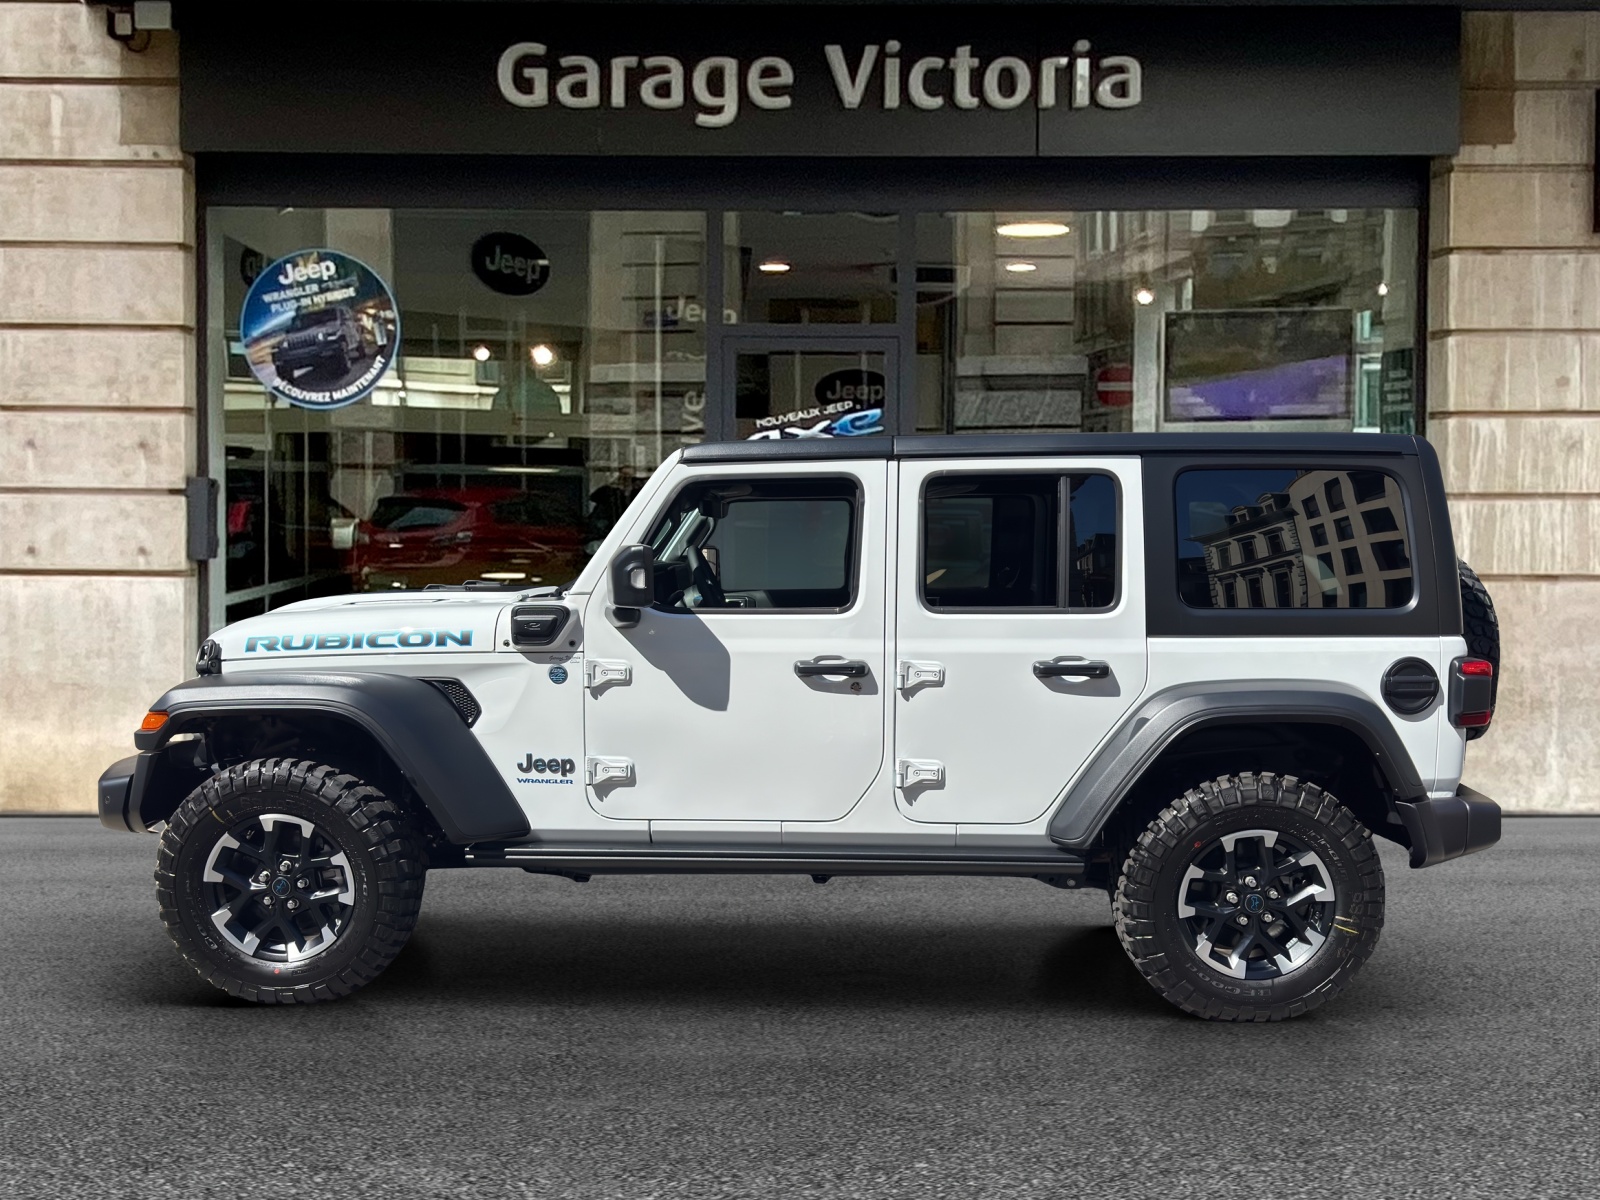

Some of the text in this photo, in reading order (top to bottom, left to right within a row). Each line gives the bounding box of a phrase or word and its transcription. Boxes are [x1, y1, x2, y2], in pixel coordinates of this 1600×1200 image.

[497, 39, 1142, 128] Garage Victoria
[278, 259, 337, 285] Jeep
[485, 245, 541, 284] Jeep
[262, 283, 320, 303] WRANGLER
[667, 297, 737, 325] Jep
[272, 355, 386, 402] DÉCOUVREZ MAINTENANT
[826, 379, 884, 405] Jeep
[755, 400, 854, 428] NOUVEAUX JEEP
[244, 630, 474, 653] RUBICON
[516, 752, 576, 777] Jeep
